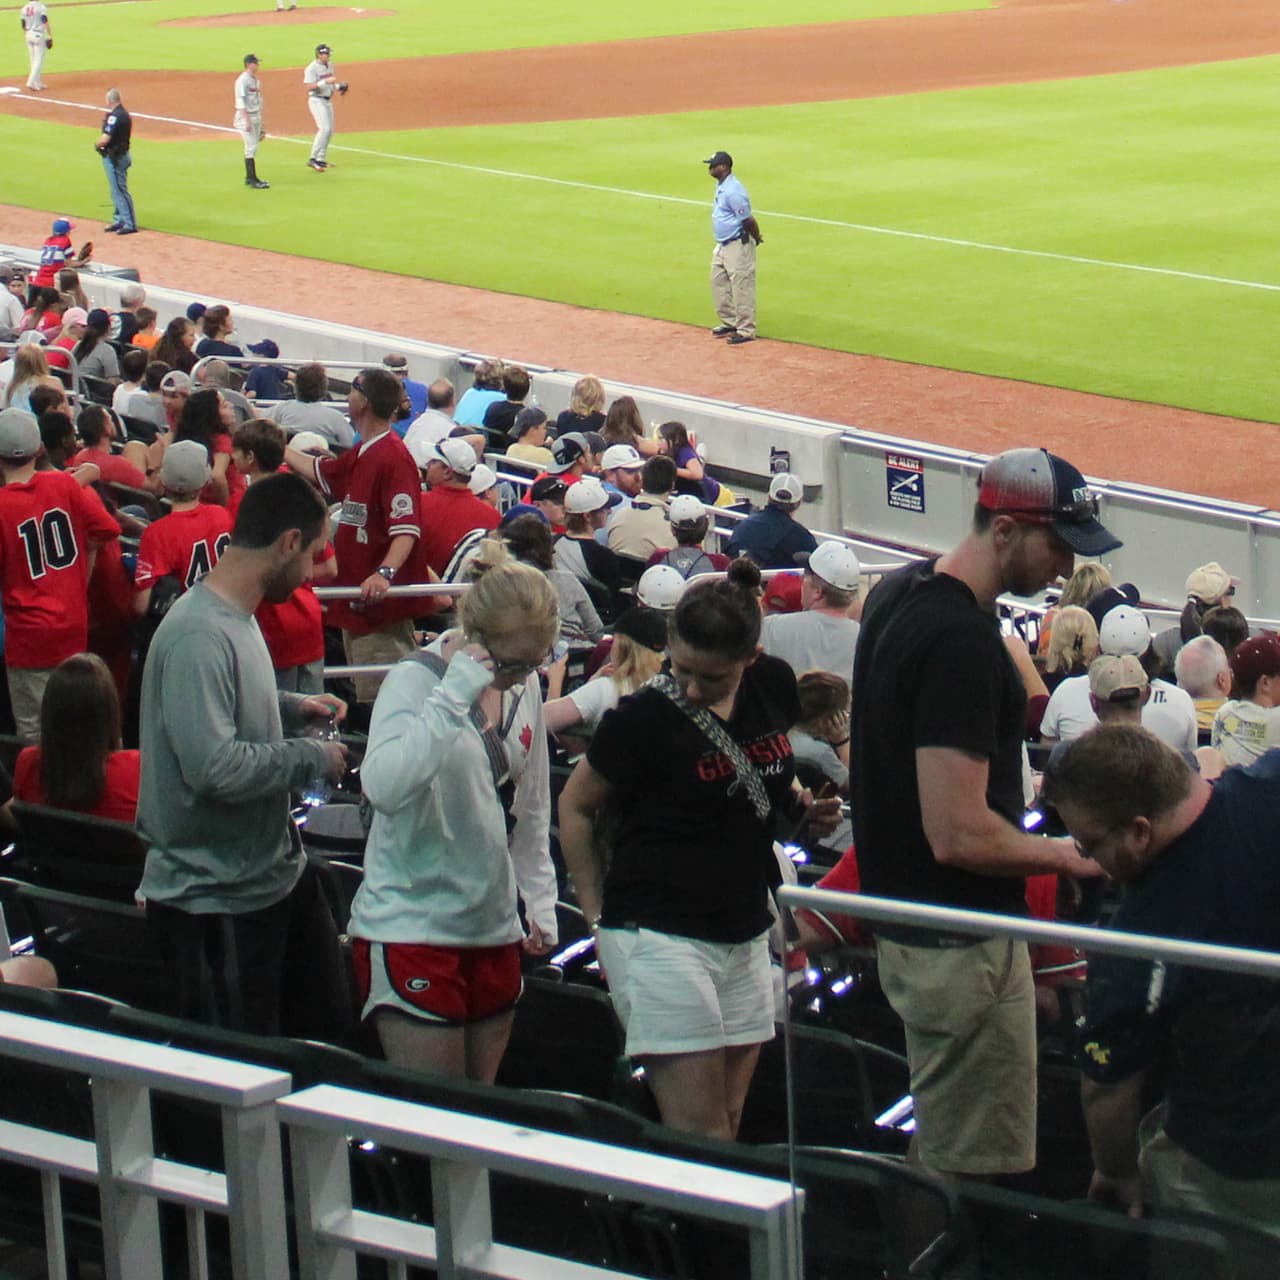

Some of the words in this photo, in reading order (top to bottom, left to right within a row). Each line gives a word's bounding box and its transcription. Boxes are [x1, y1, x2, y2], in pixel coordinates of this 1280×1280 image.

[899, 457, 920, 470] ALERT
[17, 507, 78, 579] 10
[1153, 690, 1168, 703] IT.
[697, 733, 793, 782] GEGIA
